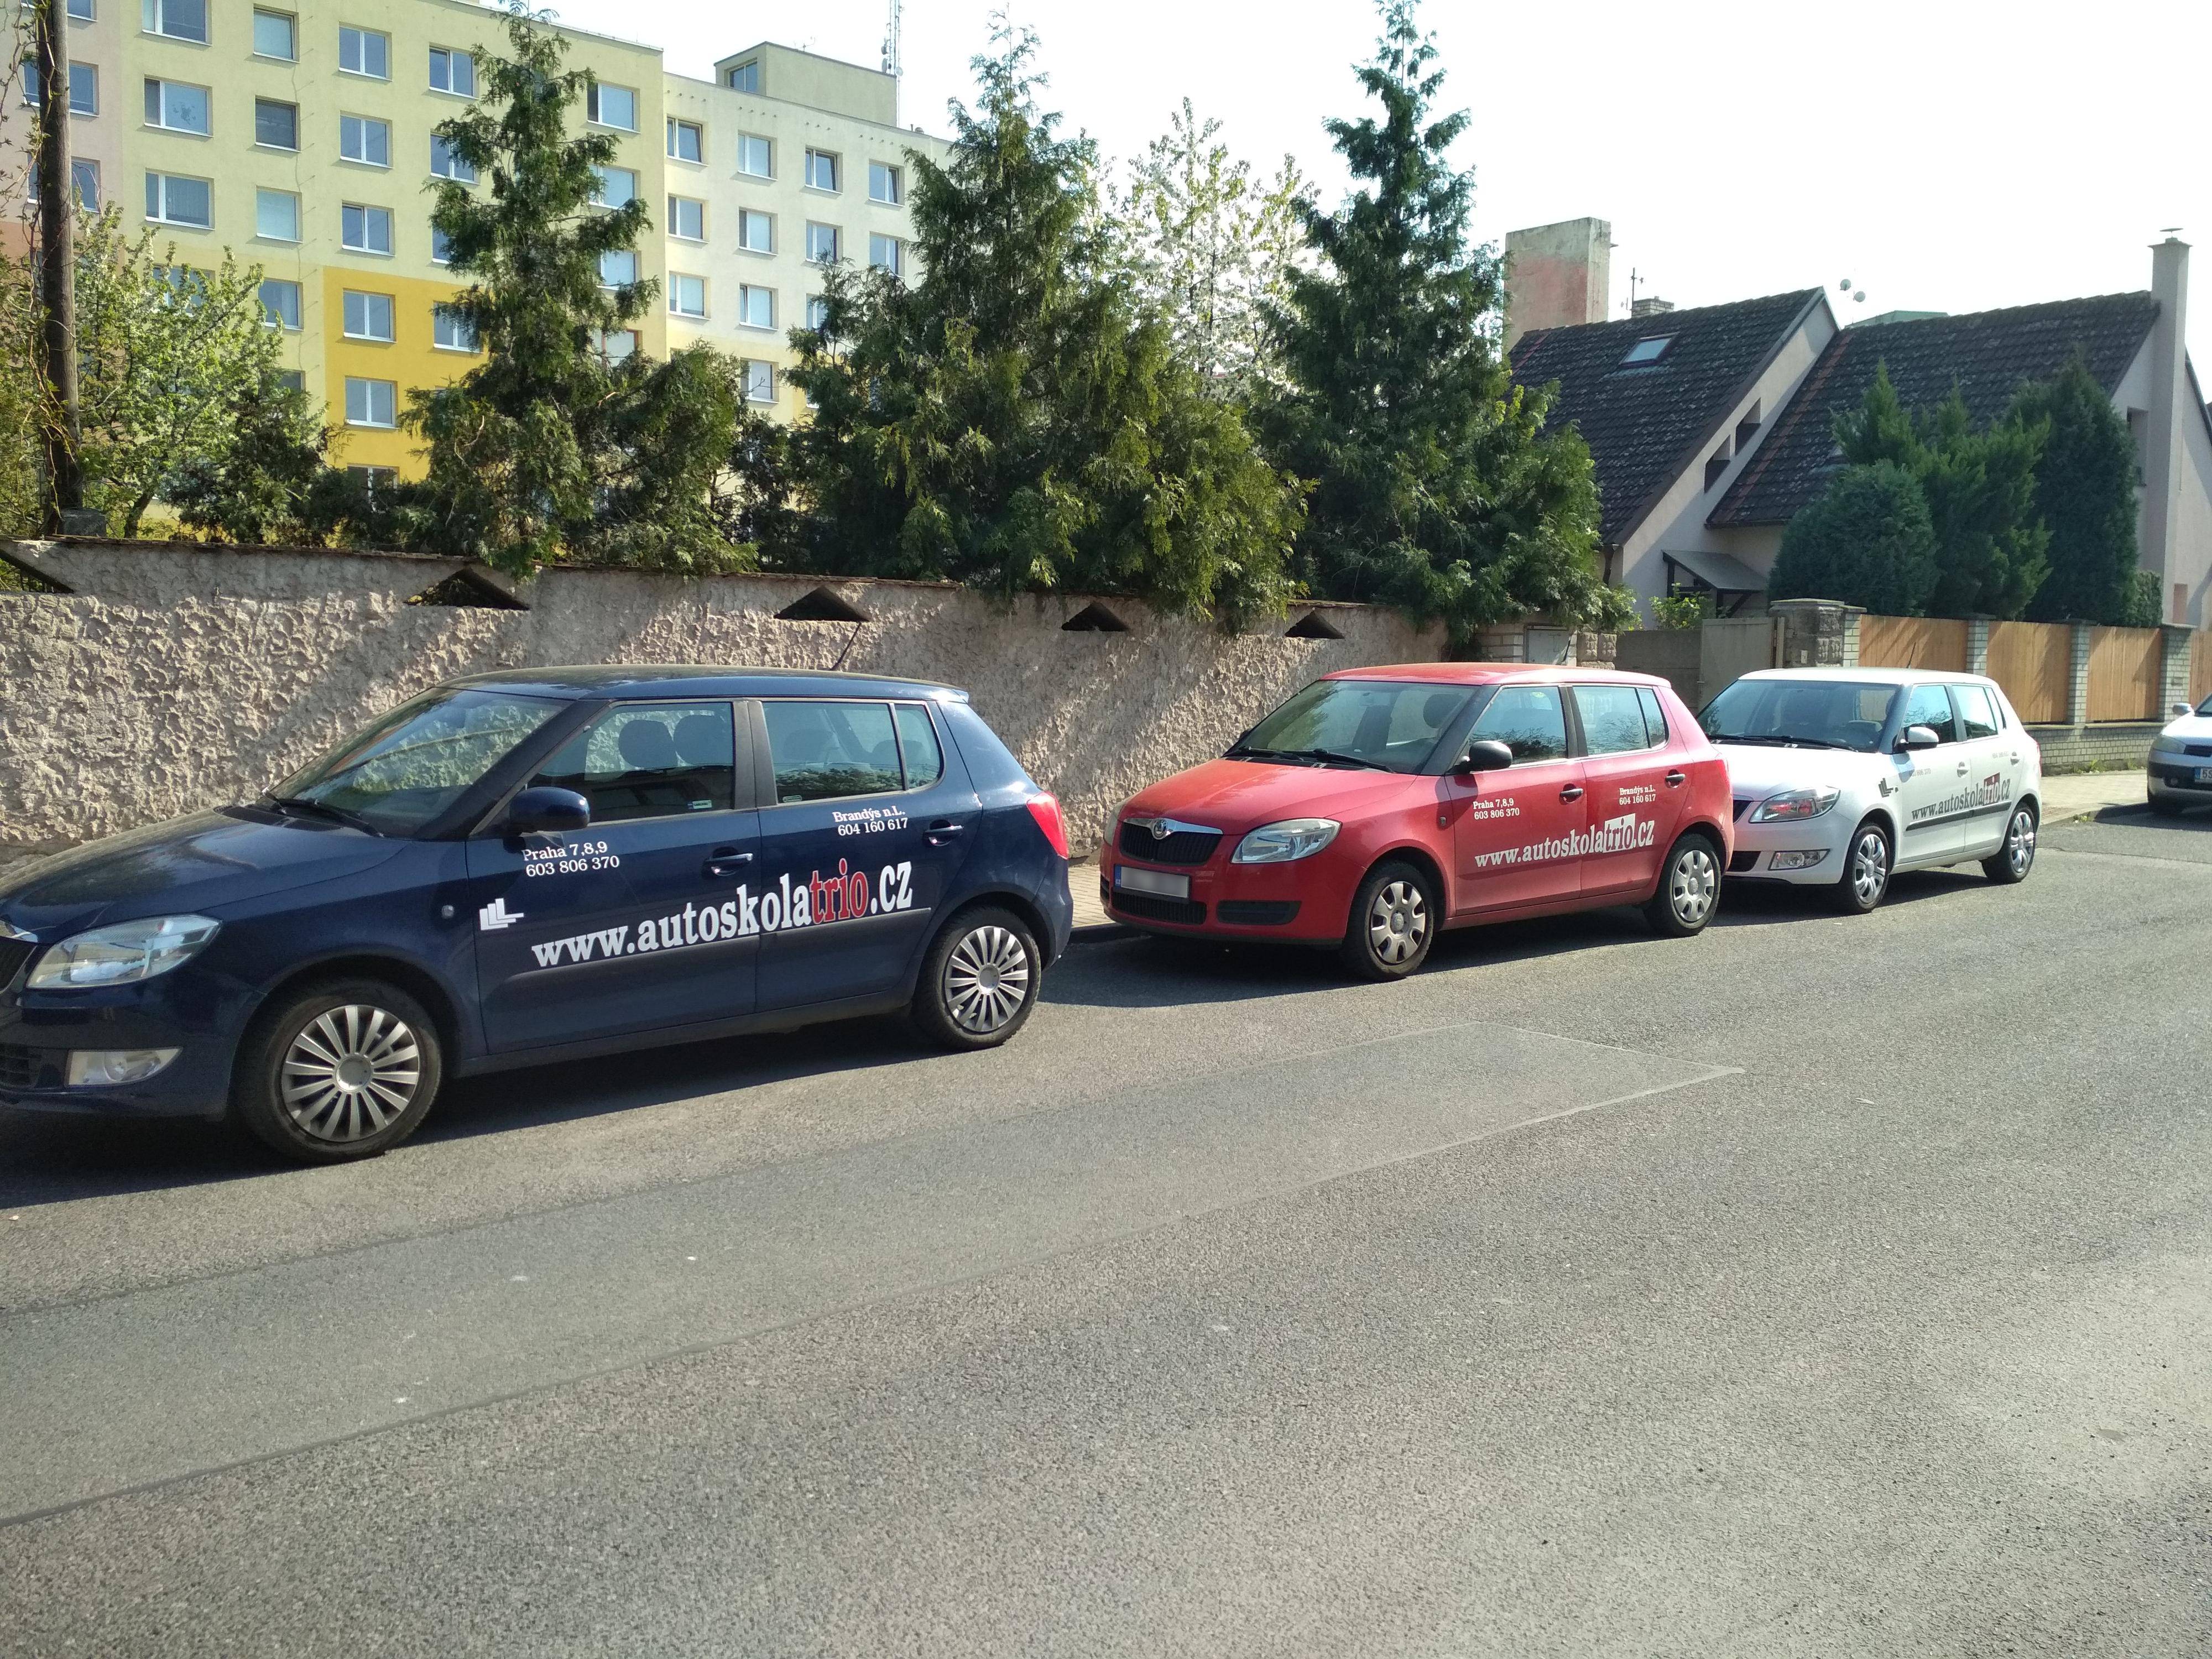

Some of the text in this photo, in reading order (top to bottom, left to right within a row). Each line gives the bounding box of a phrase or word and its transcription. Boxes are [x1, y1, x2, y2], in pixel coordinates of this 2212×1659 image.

[1619, 784, 1656, 795] Brandýs n.L.
[1911, 775, 2011, 820] www.autoskolatrio.cz
[1473, 797, 1514, 809] Praha 7,8,9
[1619, 794, 1656, 805] 604 160 617
[832, 805, 906, 822] Brandýs n.L.
[1474, 807, 1520, 820] 603 806 370
[837, 817, 908, 836] 604 160 617
[521, 841, 608, 861] Praha 7,8,9
[1474, 815, 1655, 868] www.autoskolatrio.cz
[525, 855, 620, 877] 603 806 370
[532, 858, 912, 967] www.autoskolatrio.cz
